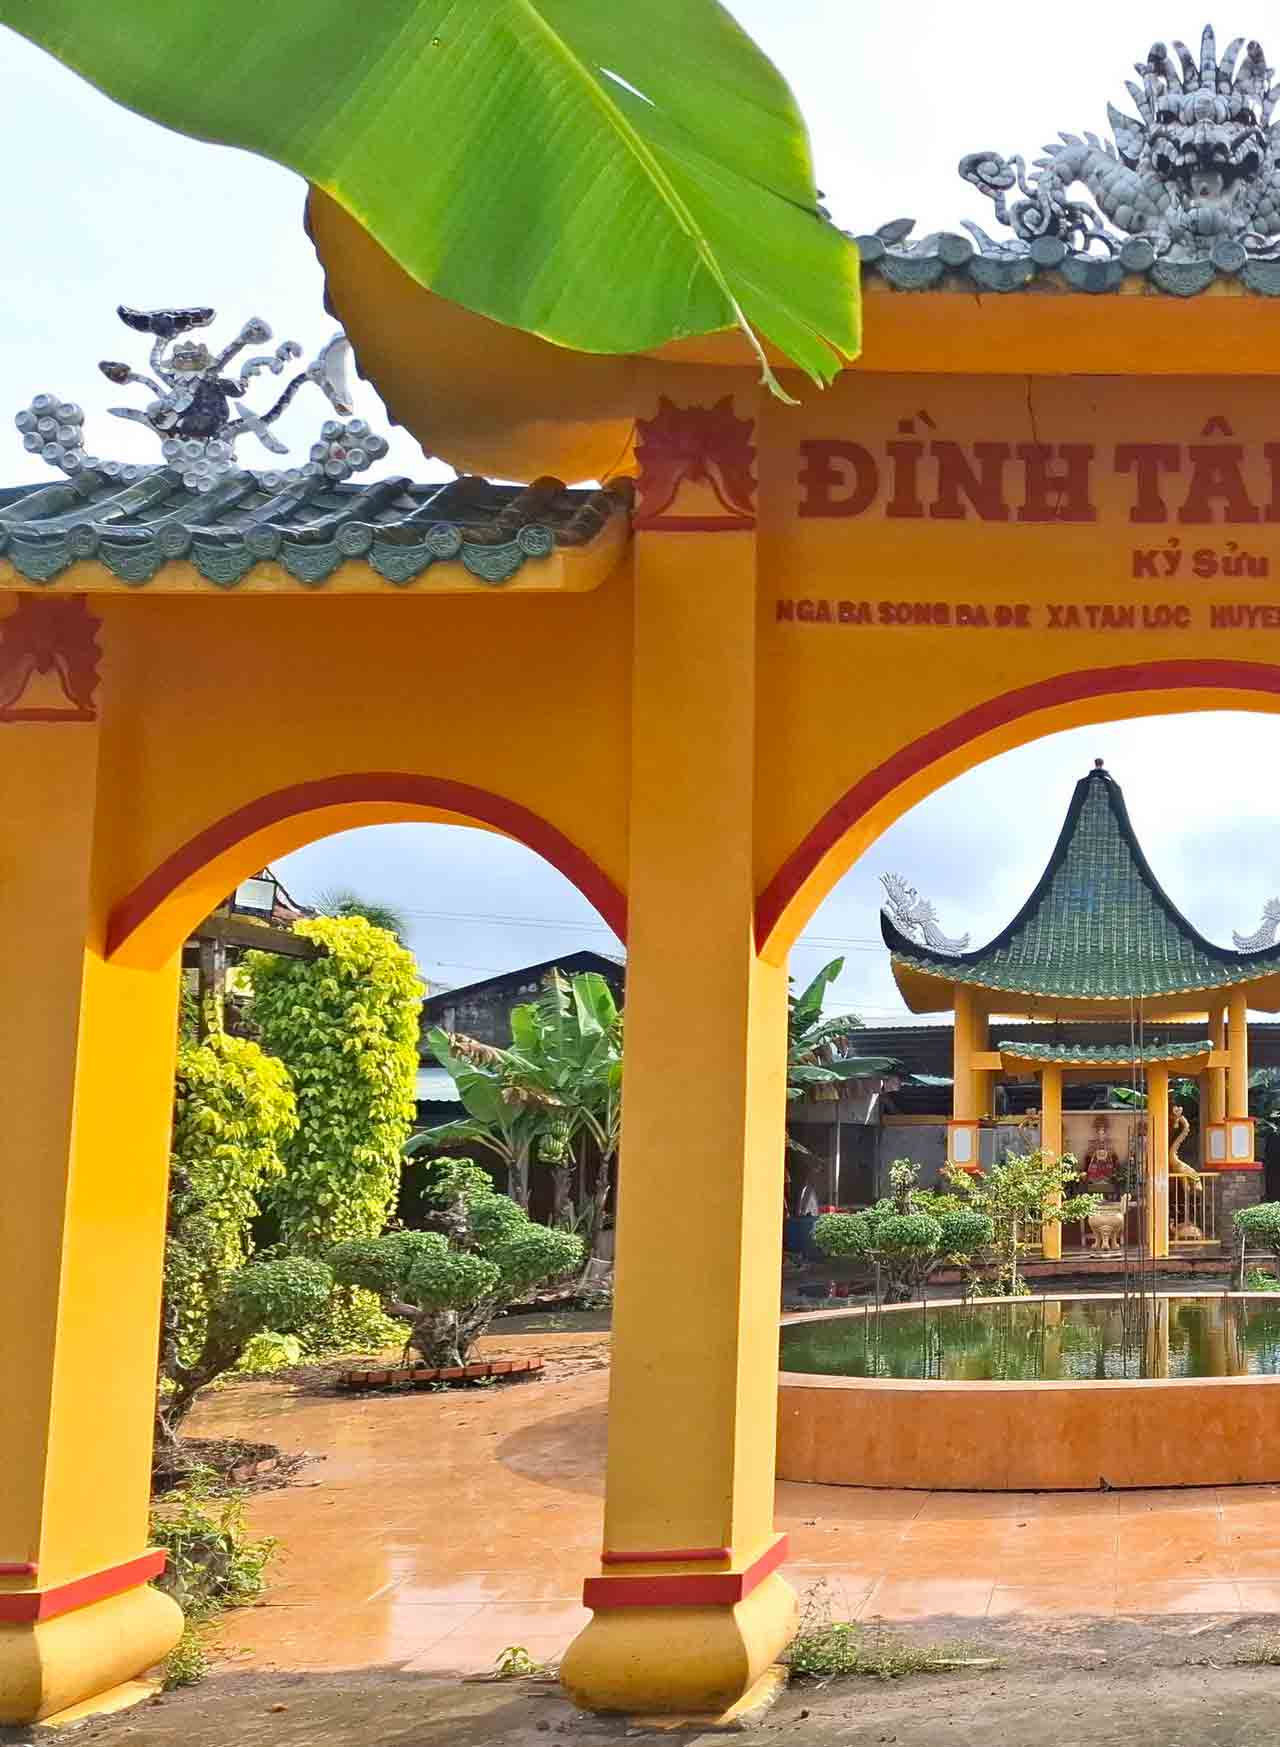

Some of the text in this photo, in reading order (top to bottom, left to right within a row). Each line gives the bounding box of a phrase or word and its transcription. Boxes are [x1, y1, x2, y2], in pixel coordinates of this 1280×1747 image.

[798, 410, 1096, 522] ĐÌNH
[1132, 537, 1269, 578] Kỷ Sửu
[776, 600, 831, 622] NGA
[838, 601, 873, 624] BA
[879, 601, 949, 625] SONG
[1047, 604, 1082, 628] XA
[1084, 604, 1135, 628] TAN
[1143, 604, 1191, 628] LOC
